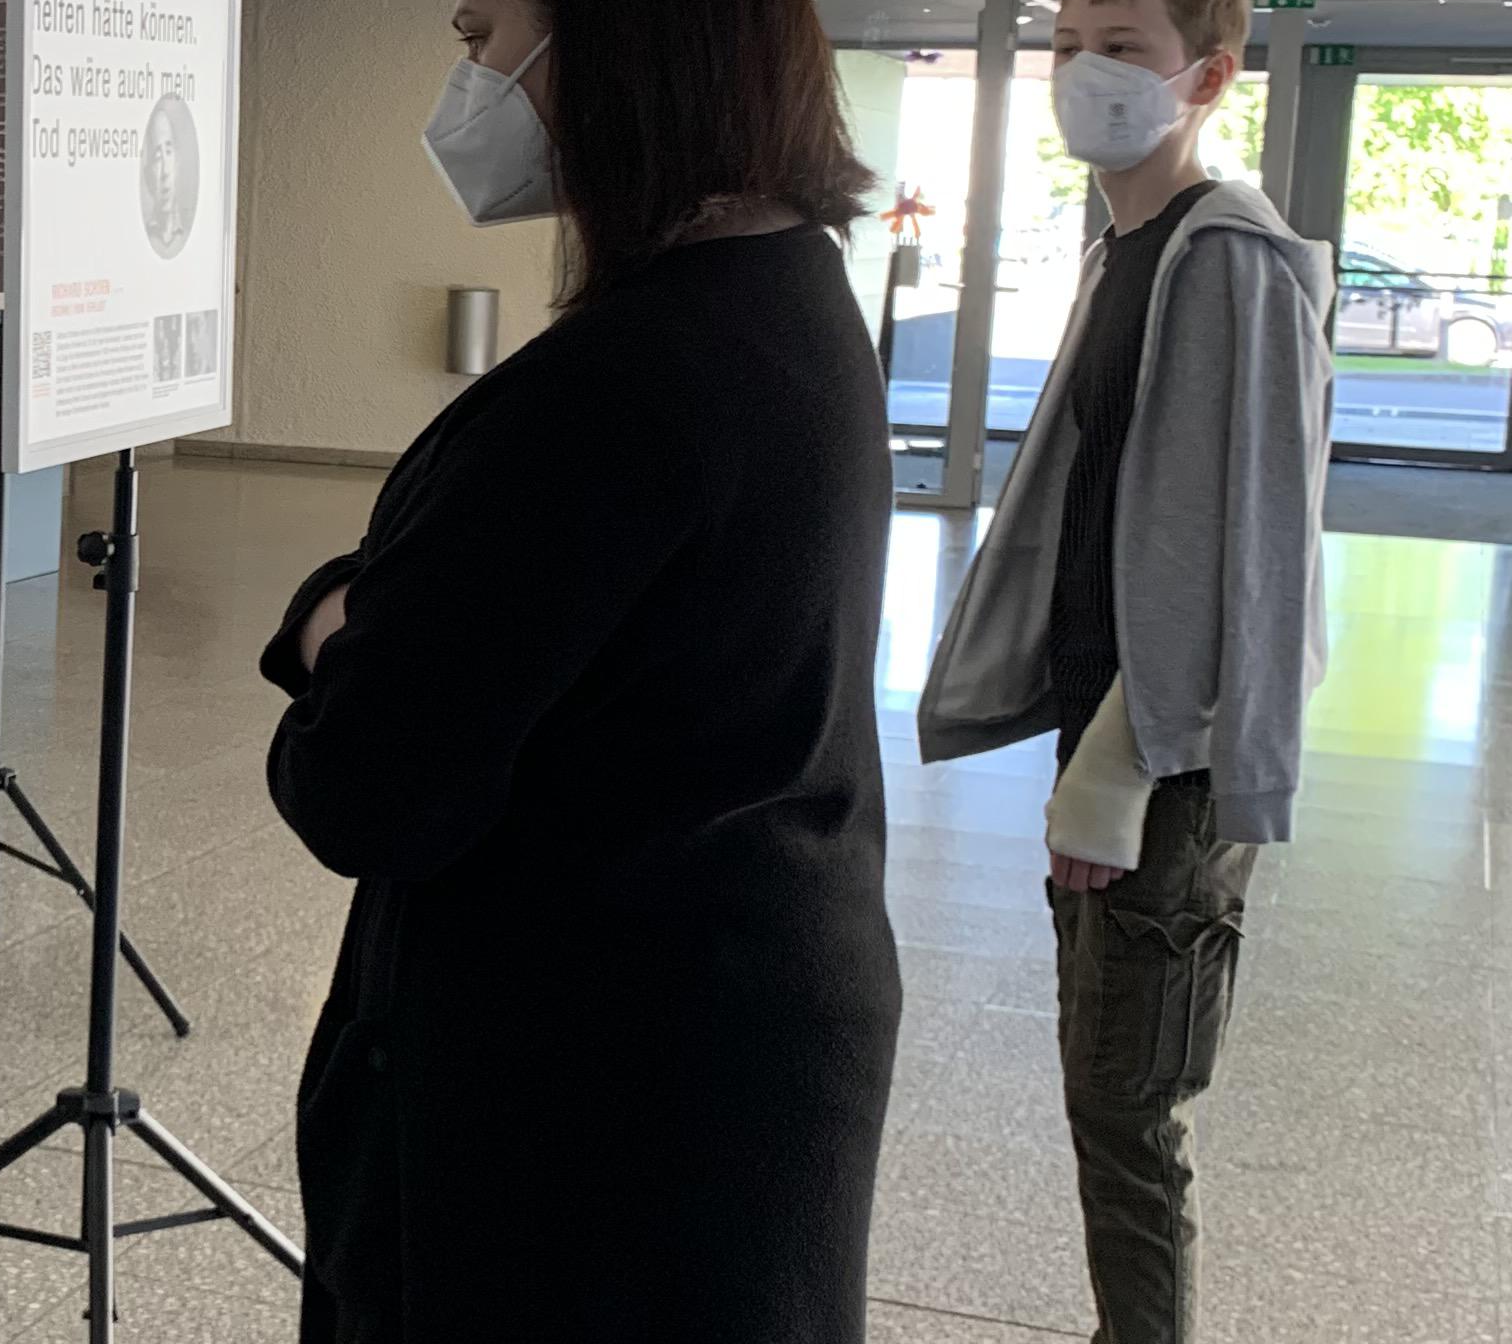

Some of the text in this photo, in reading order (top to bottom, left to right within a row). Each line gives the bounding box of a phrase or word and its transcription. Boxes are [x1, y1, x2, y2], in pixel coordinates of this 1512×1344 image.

[140, 2, 197, 45] können.
[32, 54, 196, 102] Das wäre auch mein
[32, 118, 60, 159] Tod
